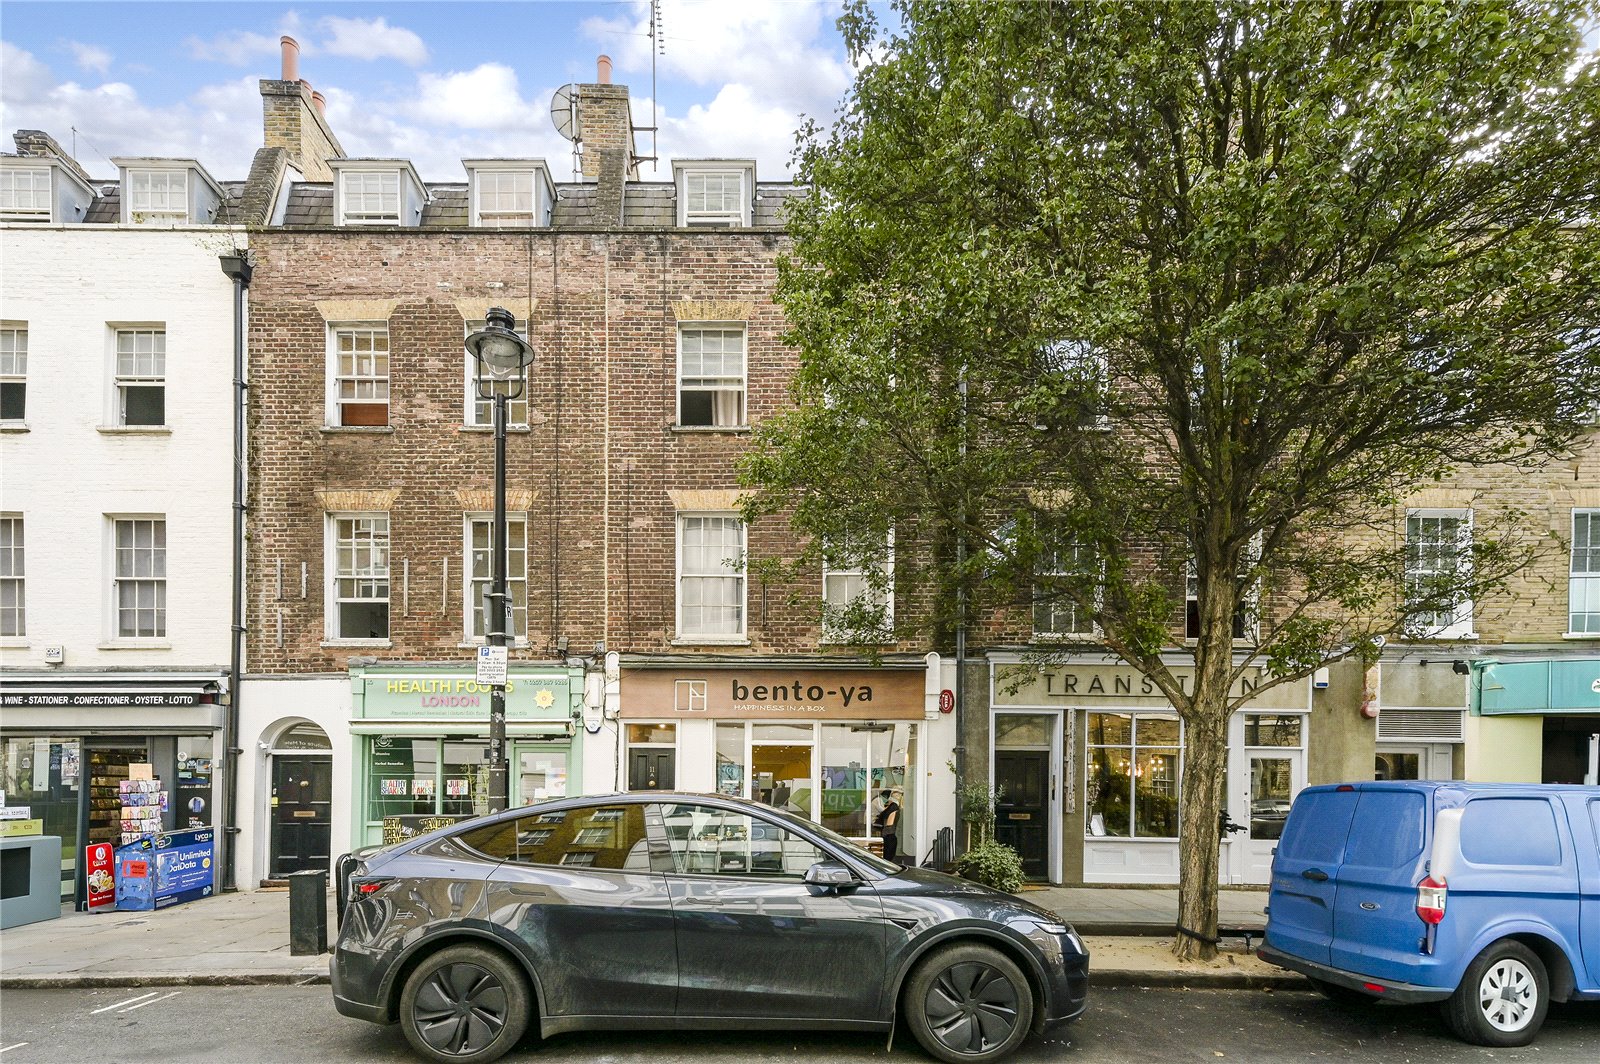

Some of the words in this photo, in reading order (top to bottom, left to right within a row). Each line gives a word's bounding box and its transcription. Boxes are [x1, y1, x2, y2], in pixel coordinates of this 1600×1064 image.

[387, 680, 451, 694] HEALTH
[455, 680, 514, 694] FOOS
[1043, 673, 1259, 695] TRANSTN
[732, 679, 873, 707] bento-ya
[4, 696, 23, 704] WINE
[28, 696, 69, 704] STATIONER
[74, 696, 130, 704] CONFECTIONER
[135, 696, 164, 704] OYSTER
[169, 696, 193, 704] LOTTO
[421, 696, 480, 708] LONDON
[381, 787, 405, 795] SHAKES
[452, 787, 465, 795] BAR
[195, 833, 209, 842] Lyca
[179, 848, 211, 861] Unlimited
